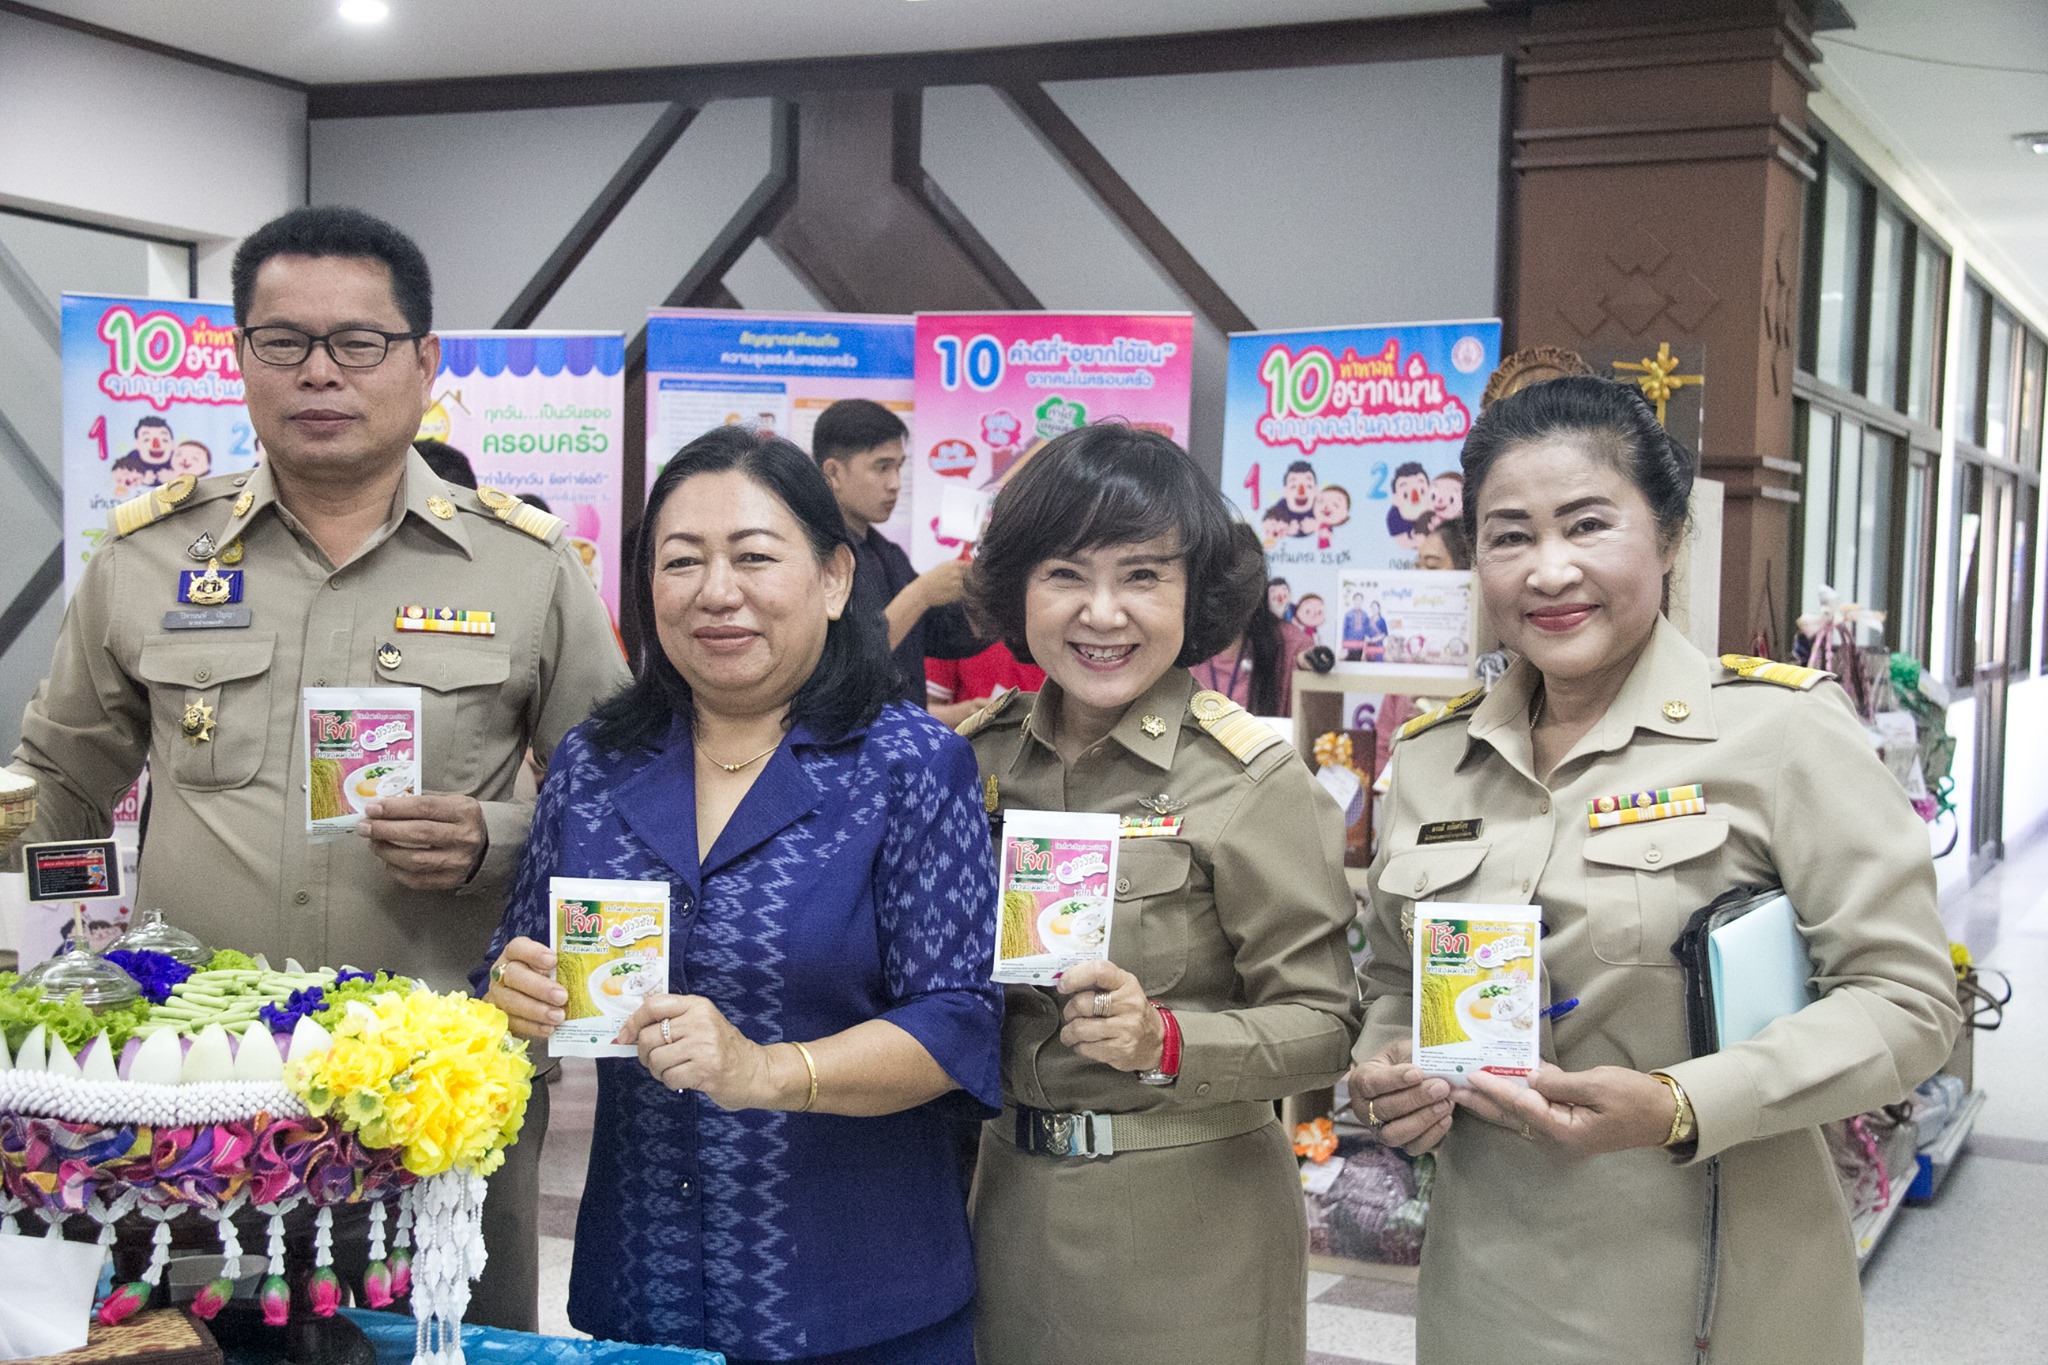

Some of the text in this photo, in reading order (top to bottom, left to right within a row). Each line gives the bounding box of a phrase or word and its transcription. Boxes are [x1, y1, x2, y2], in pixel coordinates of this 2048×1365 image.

[105, 311, 185, 375] 10
[938, 338, 1002, 389] 10
[1027, 367, 1155, 389] จากคนในครอบครัว
[1266, 352, 1443, 416] 10 อยากเห็น
[88, 415, 251, 461] 1 2
[482, 425, 609, 454] ครอบครัว
[1261, 403, 1465, 447] จากบุคคลในครอบครัว
[1244, 461, 1390, 511] 1 2
[312, 711, 357, 741] โจ๊ก
[1353, 703, 1376, 731] 6
[1009, 840, 1054, 872] โจ๊ก
[560, 902, 603, 934] โจ๊ก
[1425, 922, 1470, 955] โจ๊ก
